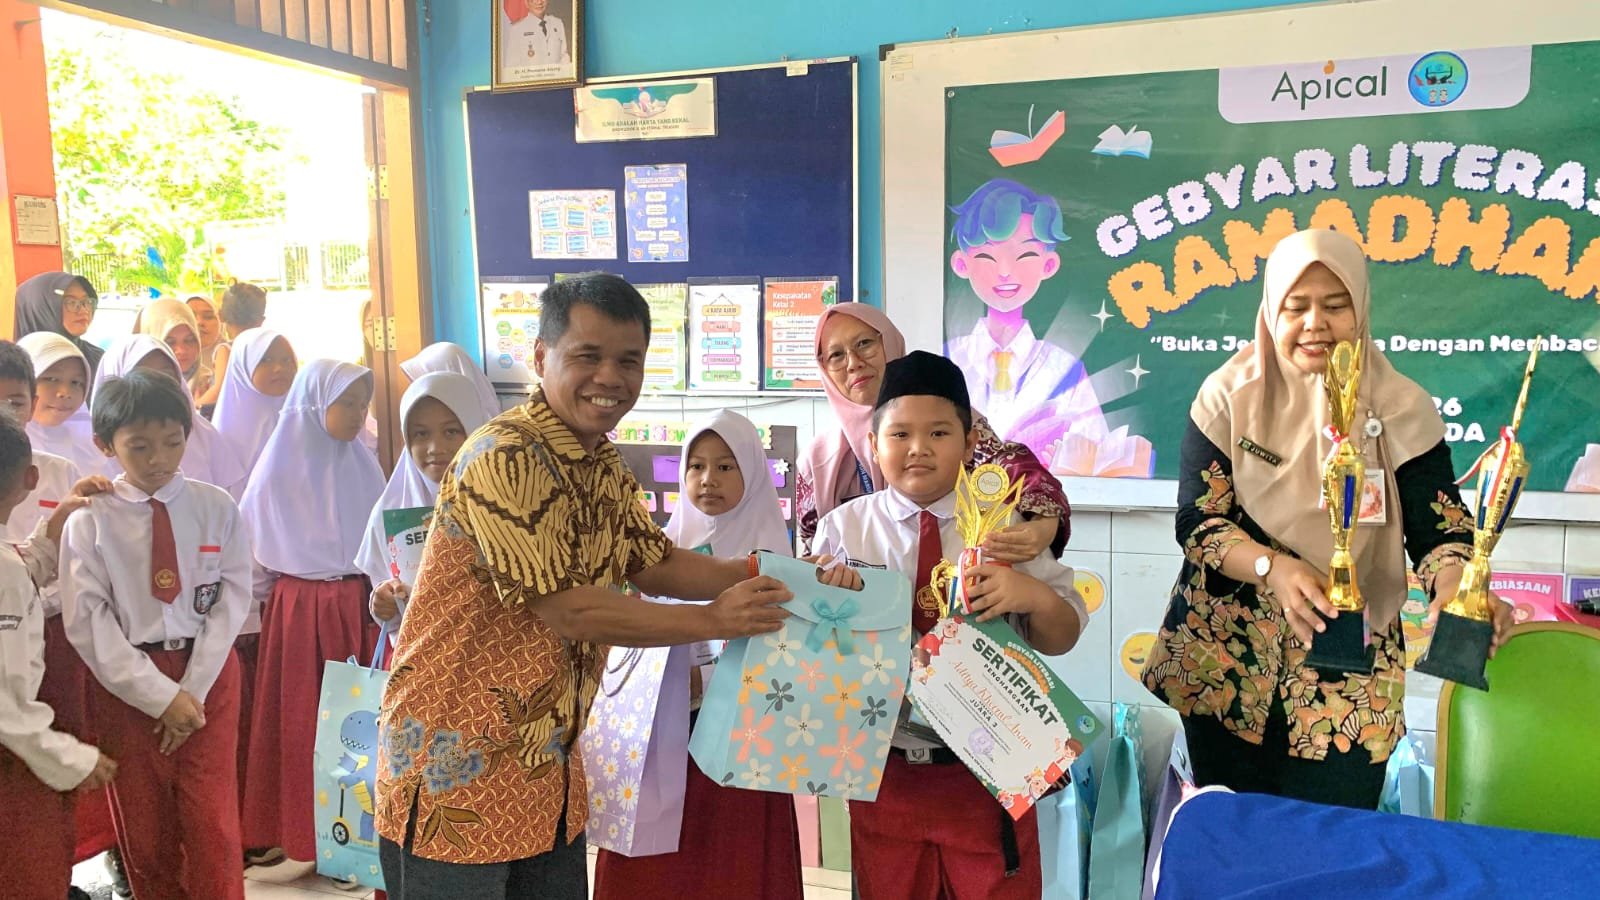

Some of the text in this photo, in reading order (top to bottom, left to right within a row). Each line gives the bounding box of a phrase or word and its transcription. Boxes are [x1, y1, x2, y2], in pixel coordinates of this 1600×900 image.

[1271, 60, 1387, 110] Apical
[1096, 149, 1337, 258] GEBYAR
[1390, 335, 1485, 356] Dengan
[1490, 335, 1600, 352] Membac
[1445, 422, 1485, 442] DA
[1249, 445, 1278, 464] JUWITA
[1488, 580, 1551, 595] EBIASAAN
[923, 610, 935, 618] SD
[973, 637, 1058, 724] SERTIFIKAT
[983, 663, 1030, 713] PENGHARGAAN
[968, 697, 992, 721] JUARA
